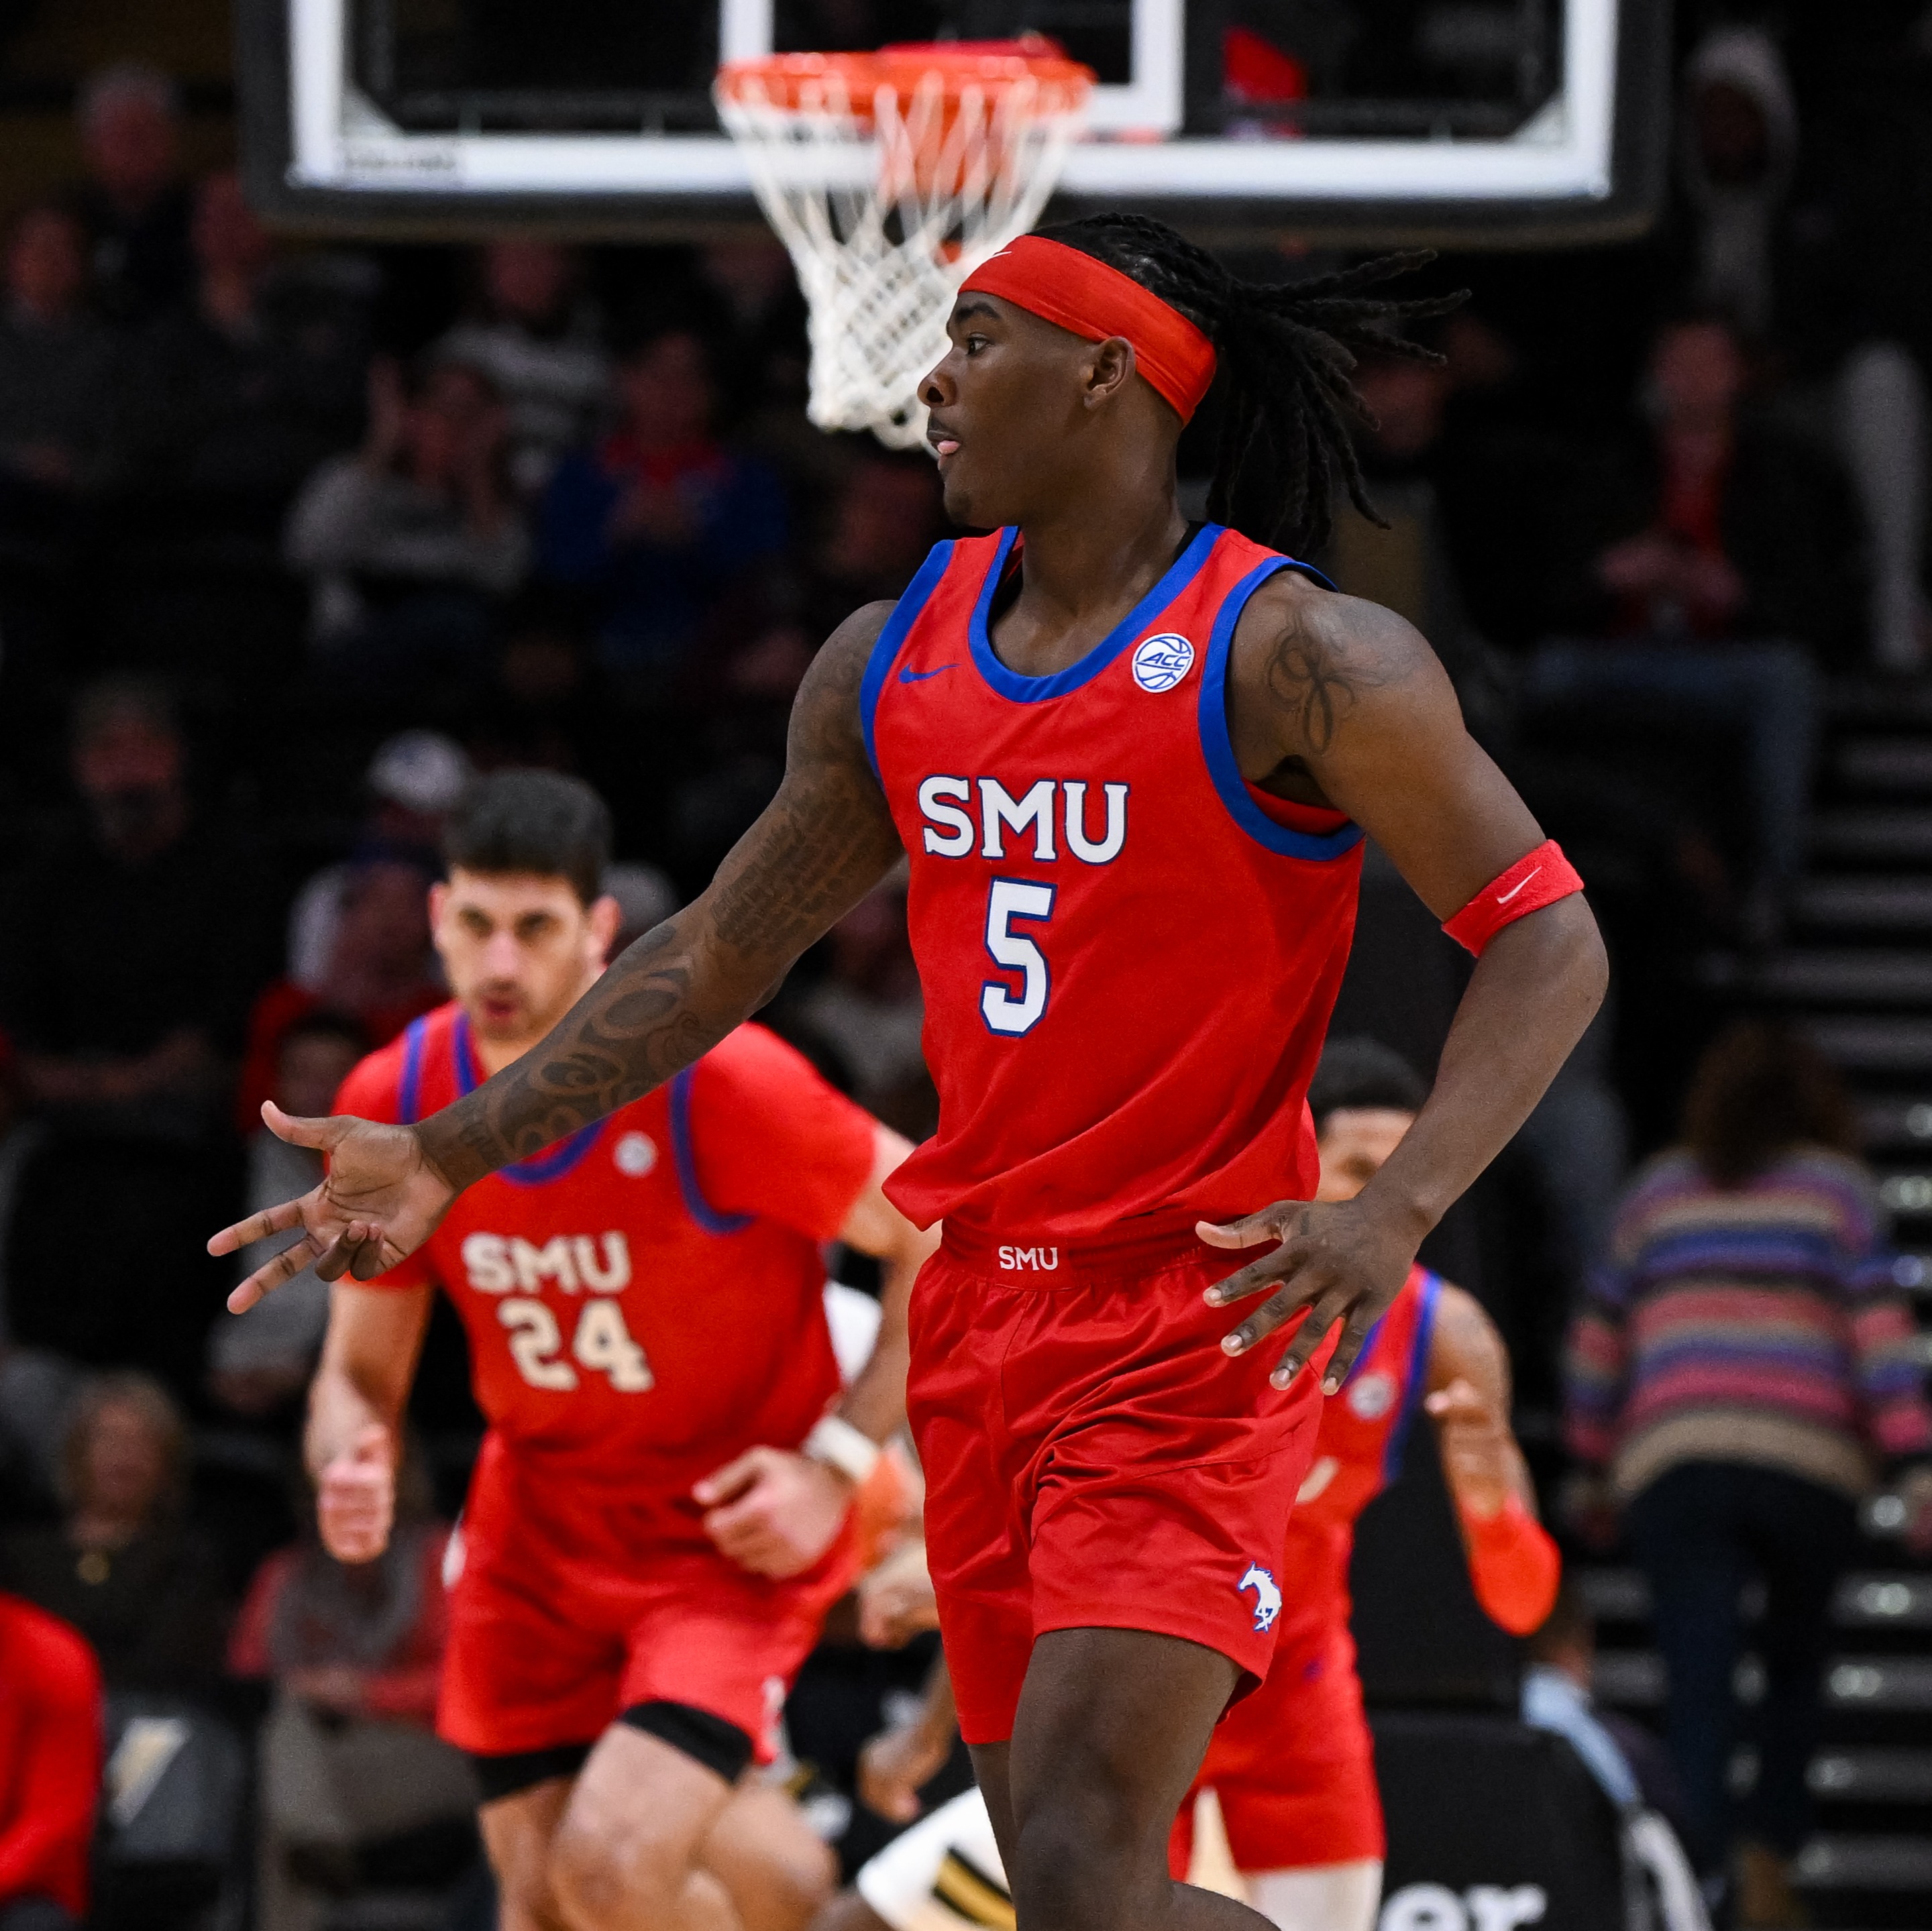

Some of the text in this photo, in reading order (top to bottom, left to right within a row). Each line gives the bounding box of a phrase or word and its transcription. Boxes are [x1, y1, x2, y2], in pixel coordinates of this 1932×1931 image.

[1141, 652, 1191, 667] ACC
[918, 775, 1130, 865] SMU
[979, 875, 1058, 1038] 5
[462, 1231, 631, 1294] SMU
[998, 1246, 1059, 1270] SMU
[497, 1298, 655, 1392] 24
